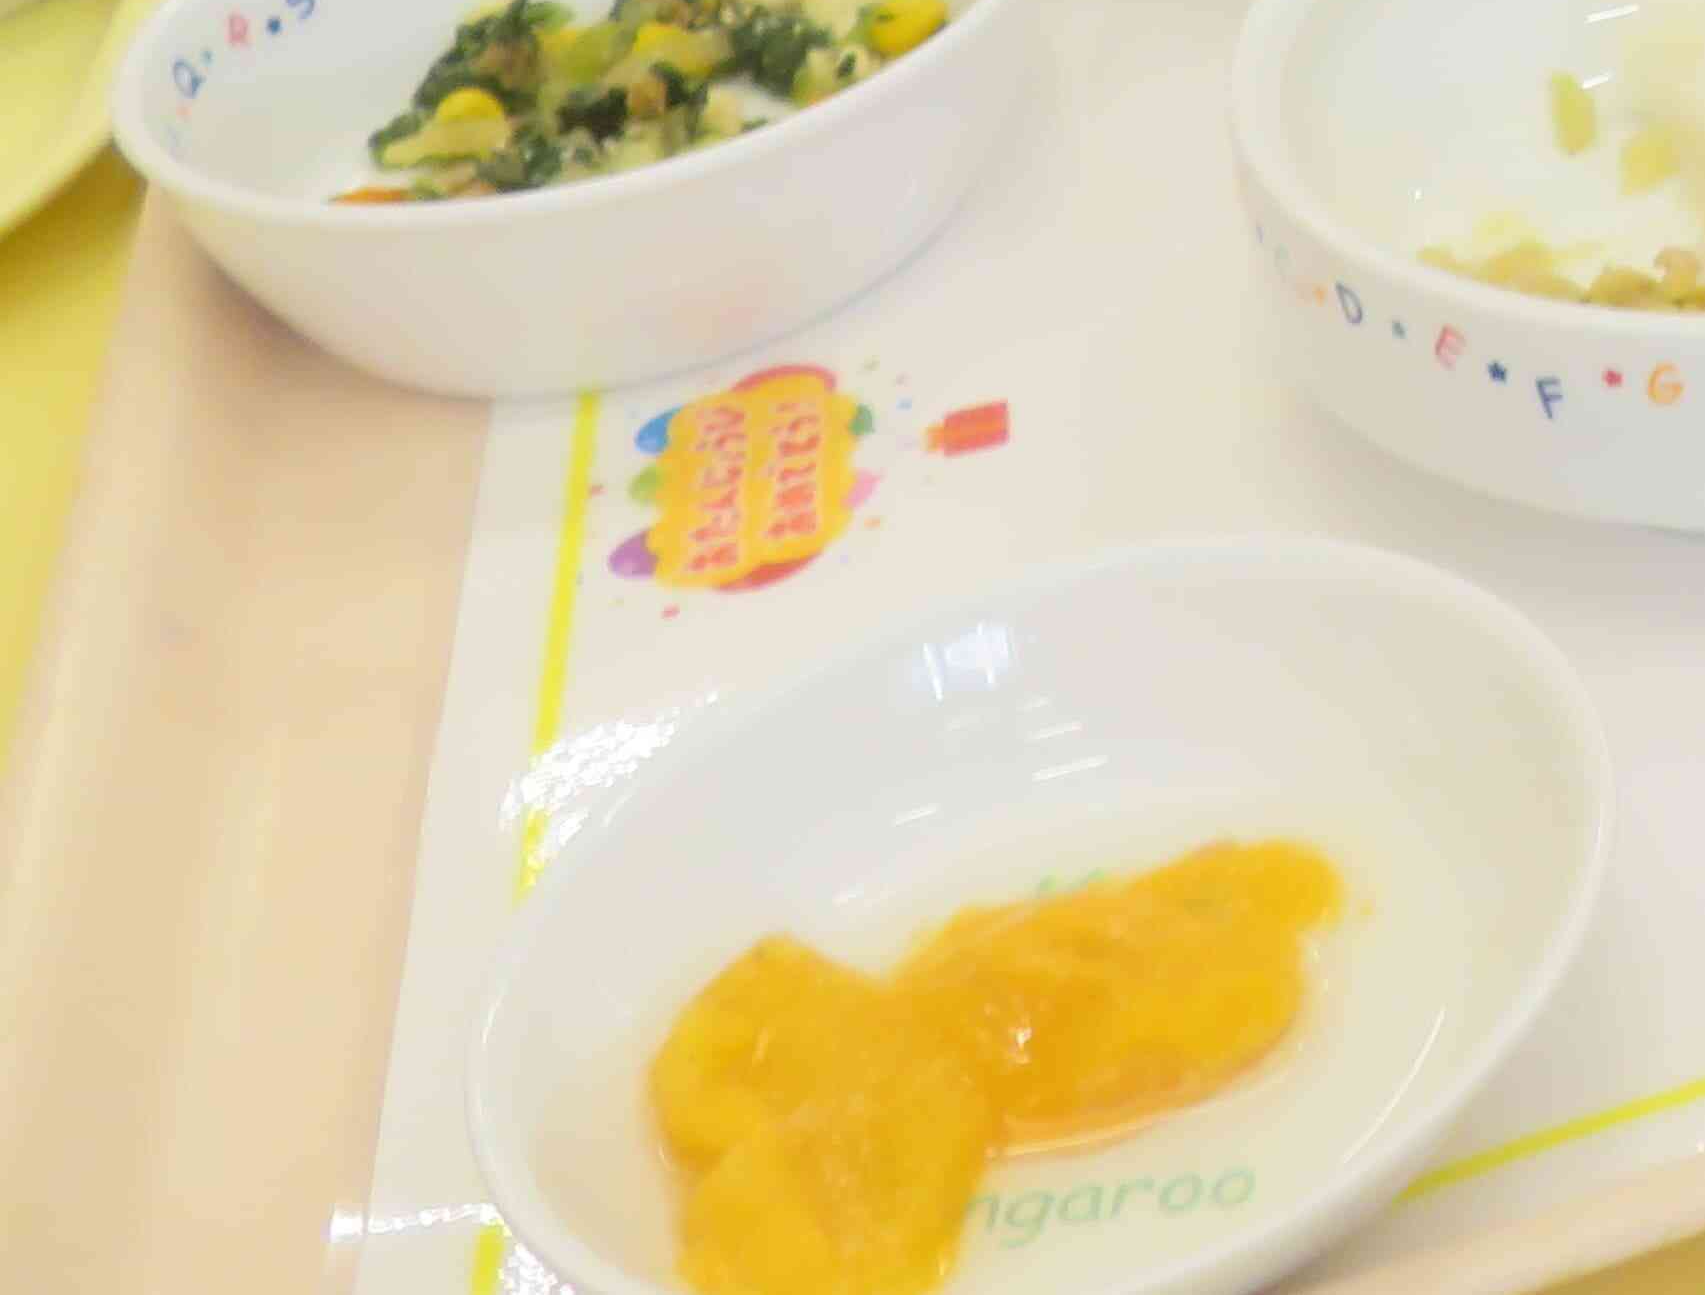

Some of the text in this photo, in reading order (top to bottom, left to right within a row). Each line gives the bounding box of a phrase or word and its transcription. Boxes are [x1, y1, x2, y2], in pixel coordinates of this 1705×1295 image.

[1535, 376, 1564, 420] F
[1646, 361, 1684, 406] G
[966, 1165, 1258, 1250] ngaroo
